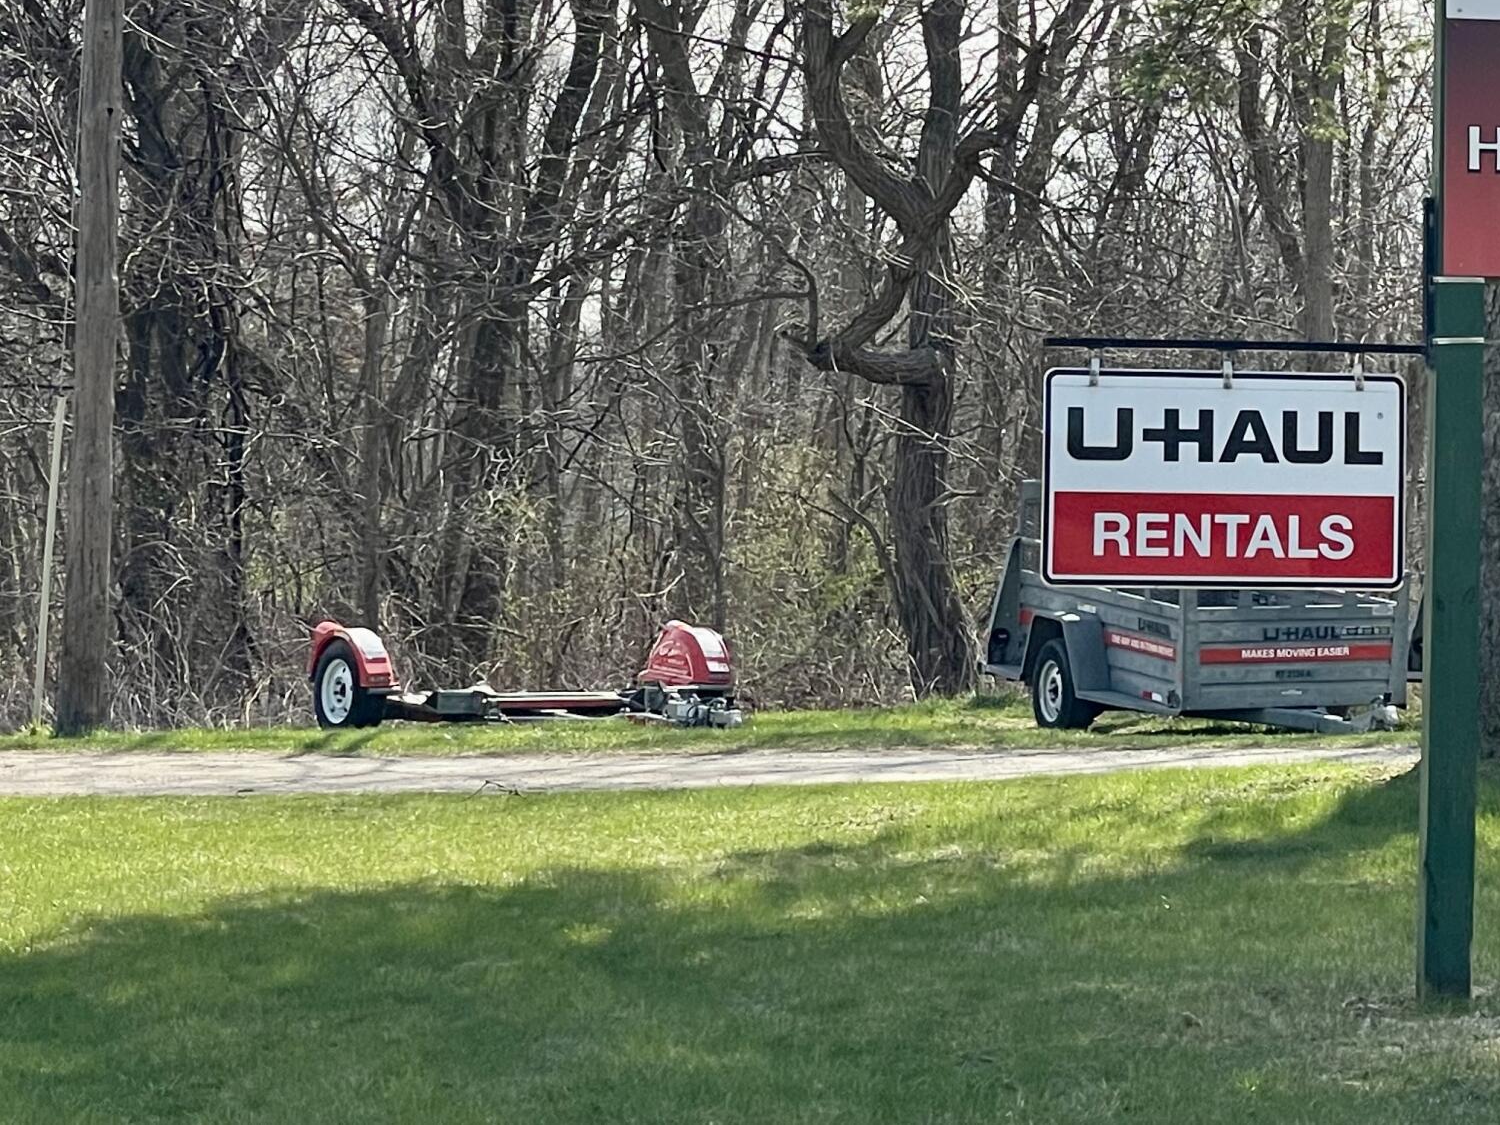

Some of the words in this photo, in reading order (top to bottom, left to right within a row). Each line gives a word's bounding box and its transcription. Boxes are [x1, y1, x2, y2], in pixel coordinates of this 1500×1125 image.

[1066, 406, 1384, 466] U-HAUL
[1092, 512, 1354, 560] RENTALS
[1241, 648, 1275, 659] MAKES
[1276, 647, 1316, 658] MOVING
[1317, 646, 1350, 657] EASIER
